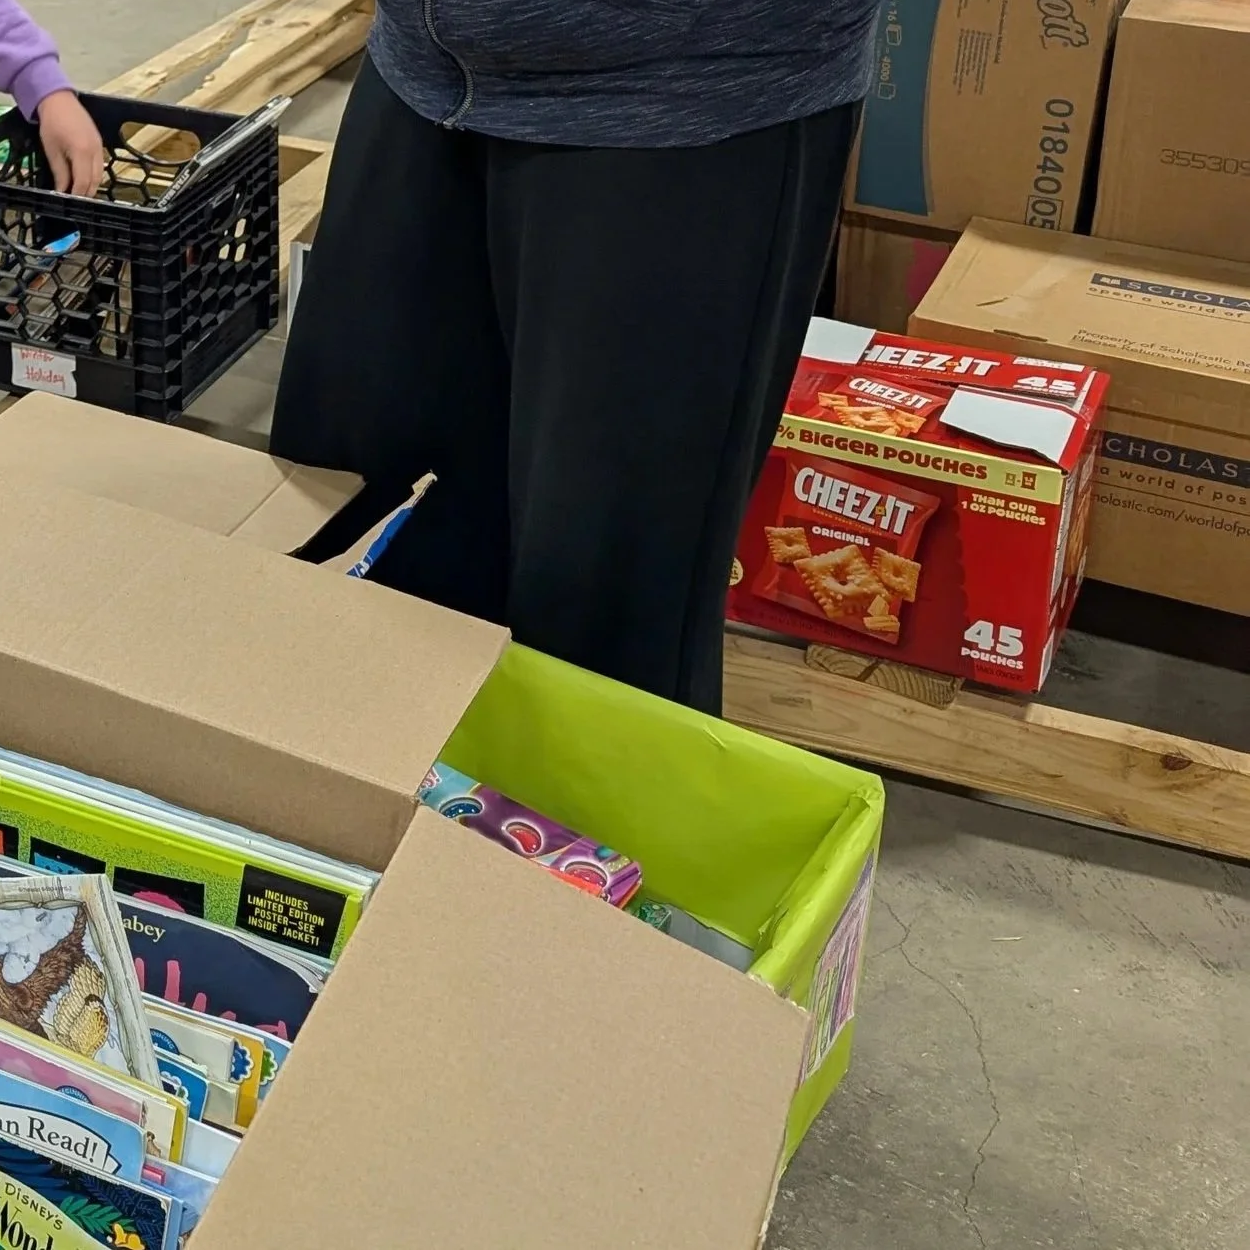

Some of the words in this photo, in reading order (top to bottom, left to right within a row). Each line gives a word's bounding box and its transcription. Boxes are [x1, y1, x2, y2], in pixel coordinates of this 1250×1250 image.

[887, 10, 898, 22] 16
[880, 56, 891, 82] 4000
[1088, 286, 1134, 299] open
[1160, 300, 1216, 313] world
[1223, 310, 1245, 318] of
[1071, 335, 1118, 349] Please
[1120, 345, 1167, 359] Return
[1170, 354, 1201, 365] with
[1206, 362, 1238, 372] your
[1077, 329, 1137, 346] Property
[1158, 345, 1232, 365] Scholastic
[26, 365, 66, 390] Holiday
[1017, 376, 1077, 391] 45
[1105, 438, 1250, 478] CHOLAS
[1100, 466, 1110, 476] a
[1119, 469, 1176, 490] world
[1184, 485, 1206, 495] of
[961, 500, 968, 509] 1
[969, 503, 987, 513] OZ
[971, 492, 1006, 508] THAN
[1008, 501, 1037, 514] OUR
[811, 525, 871, 547] ORIGINAL
[964, 619, 1024, 658] 45
[247, 894, 284, 914] LIMITED
[288, 907, 325, 926] EDITION
[264, 889, 309, 910] INCLUDES
[248, 915, 278, 933] INSIDE
[282, 926, 320, 947] JACKET!
[26, 1114, 99, 1164] Read!
